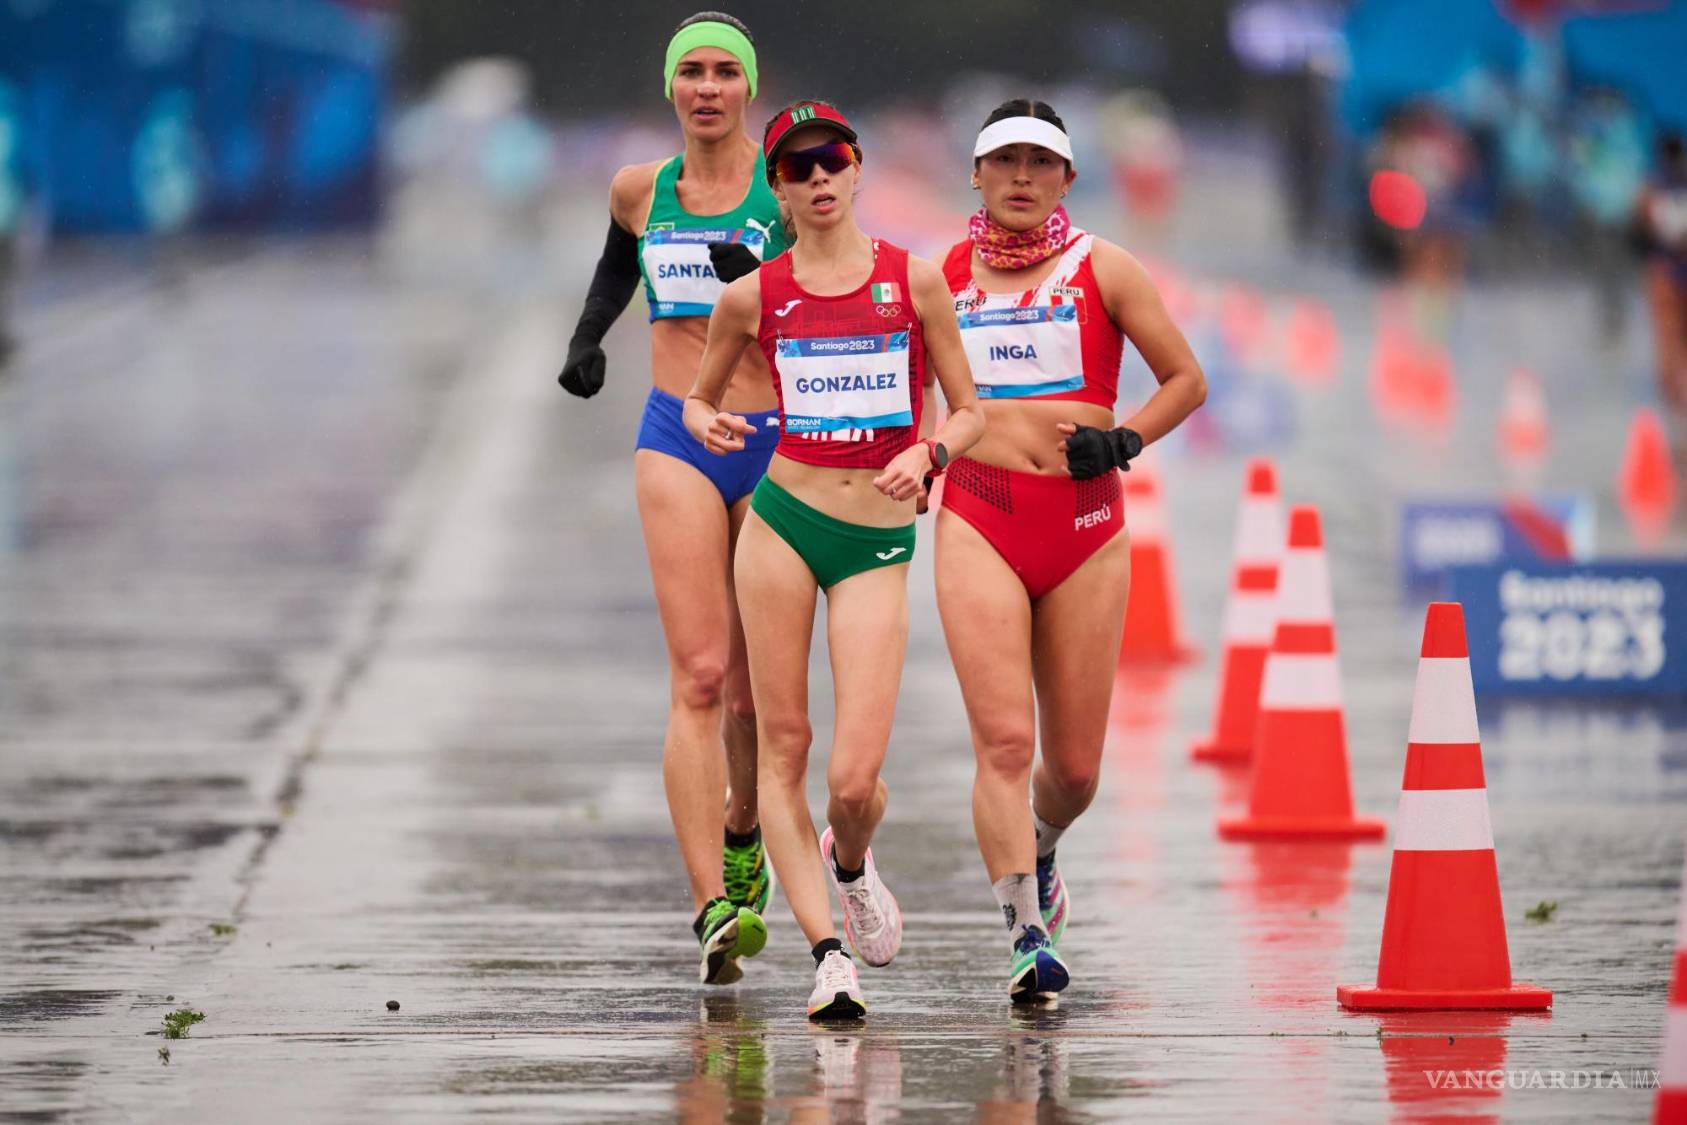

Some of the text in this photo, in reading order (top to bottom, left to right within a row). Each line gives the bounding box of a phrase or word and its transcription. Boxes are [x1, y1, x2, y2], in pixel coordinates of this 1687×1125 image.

[658, 264, 718, 278] SANTA
[989, 344, 1038, 361] INGA
[795, 372, 897, 394] GONZALEZ
[1074, 503, 1112, 531] PERÚ
[1499, 611, 1666, 680] 2023
